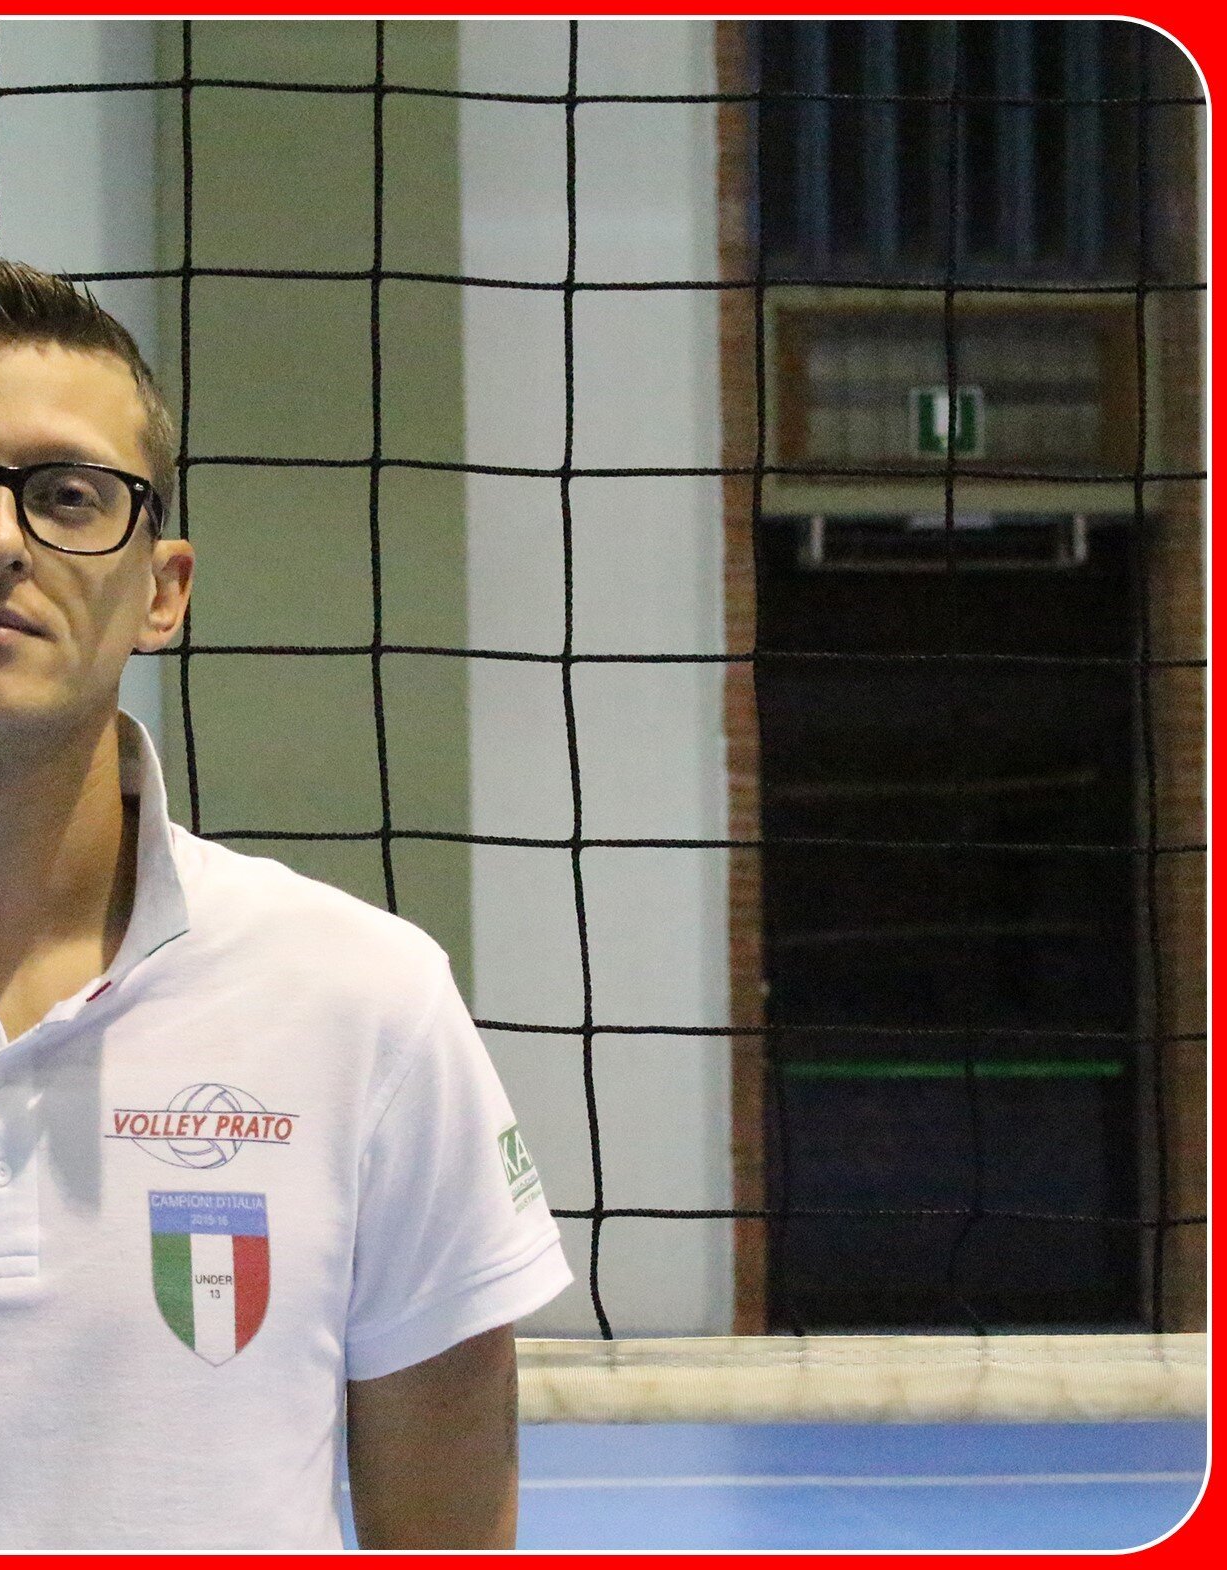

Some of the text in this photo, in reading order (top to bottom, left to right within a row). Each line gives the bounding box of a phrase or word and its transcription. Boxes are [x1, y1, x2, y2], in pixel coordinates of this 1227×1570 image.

[113, 1112, 294, 1141] VOLLEY PRATO
[498, 1130, 534, 1181] KA
[150, 1193, 213, 1208] CAMPIONI
[195, 1274, 233, 1285] UNDER
[209, 1289, 221, 1299] 13
